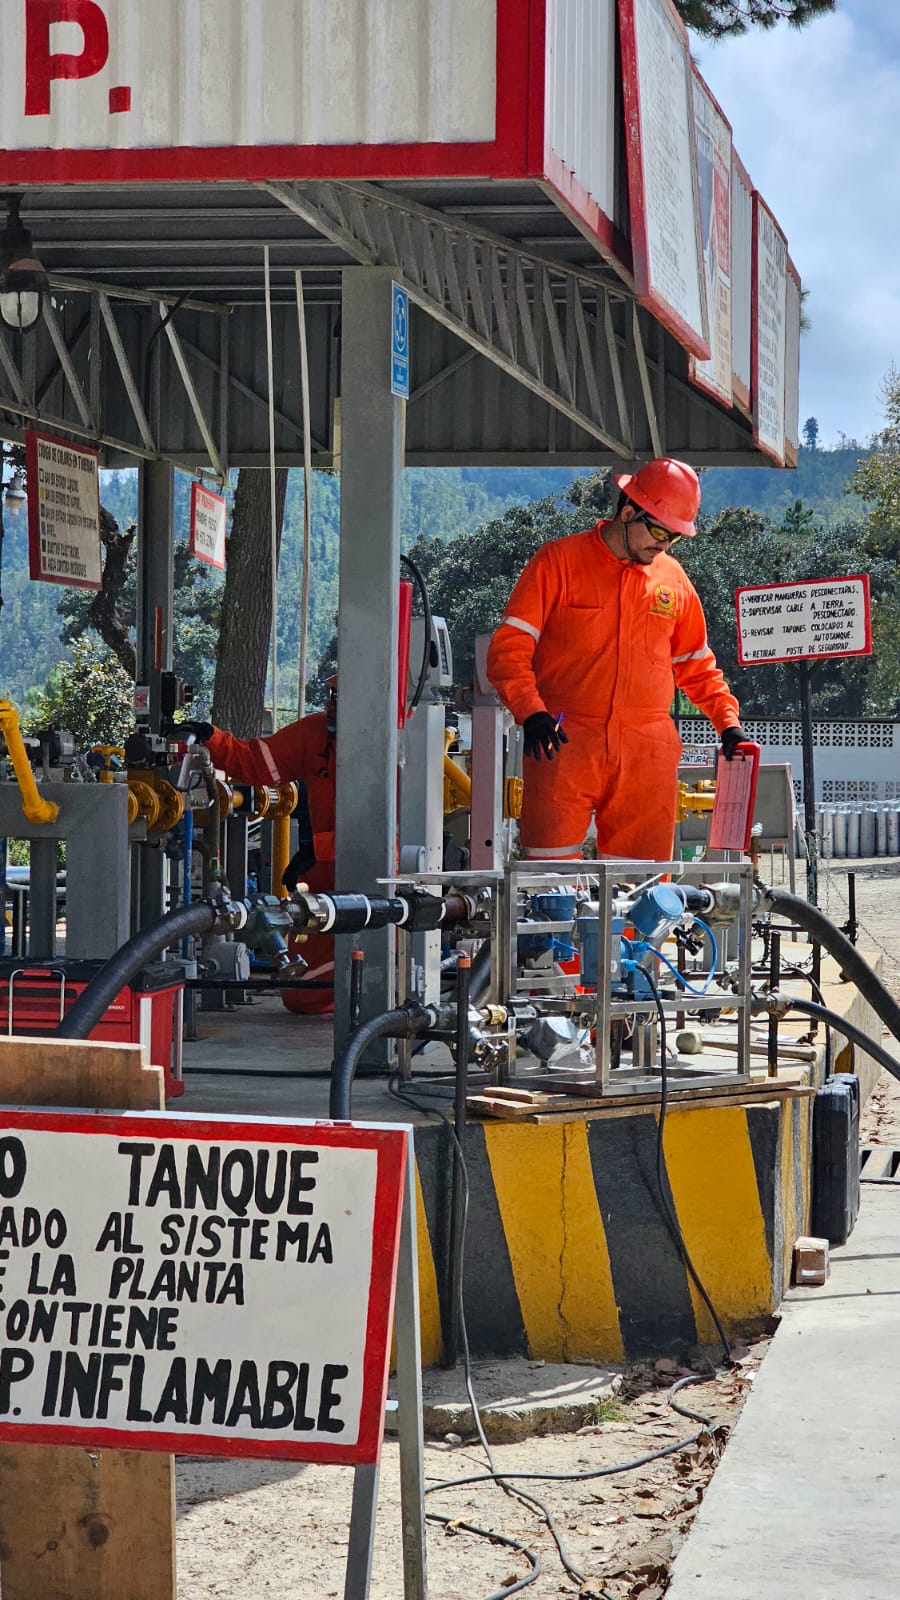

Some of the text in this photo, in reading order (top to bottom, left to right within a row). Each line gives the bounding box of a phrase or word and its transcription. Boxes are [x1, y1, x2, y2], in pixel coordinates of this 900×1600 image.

[24, 0, 131, 116] P.
[774, 590, 806, 601] MANGUERAS
[786, 603, 804, 613] CABLE
[810, 602, 816, 610] A
[822, 600, 844, 610] TIERRA
[782, 624, 806, 634] TAPONES
[810, 622, 844, 632] COLOCADOS
[786, 646, 804, 655] POSTE
[808, 645, 815, 653] DE
[118, 1142, 319, 1217] TANQUE
[96, 1212, 144, 1254] AL
[160, 1214, 333, 1264] SISTEMA
[28, 1252, 76, 1296] LA
[108, 1257, 244, 1305] PLANTA
[0, 1299, 179, 1350] ONTIENE
[42, 1350, 348, 1433] INFLAMABLE
